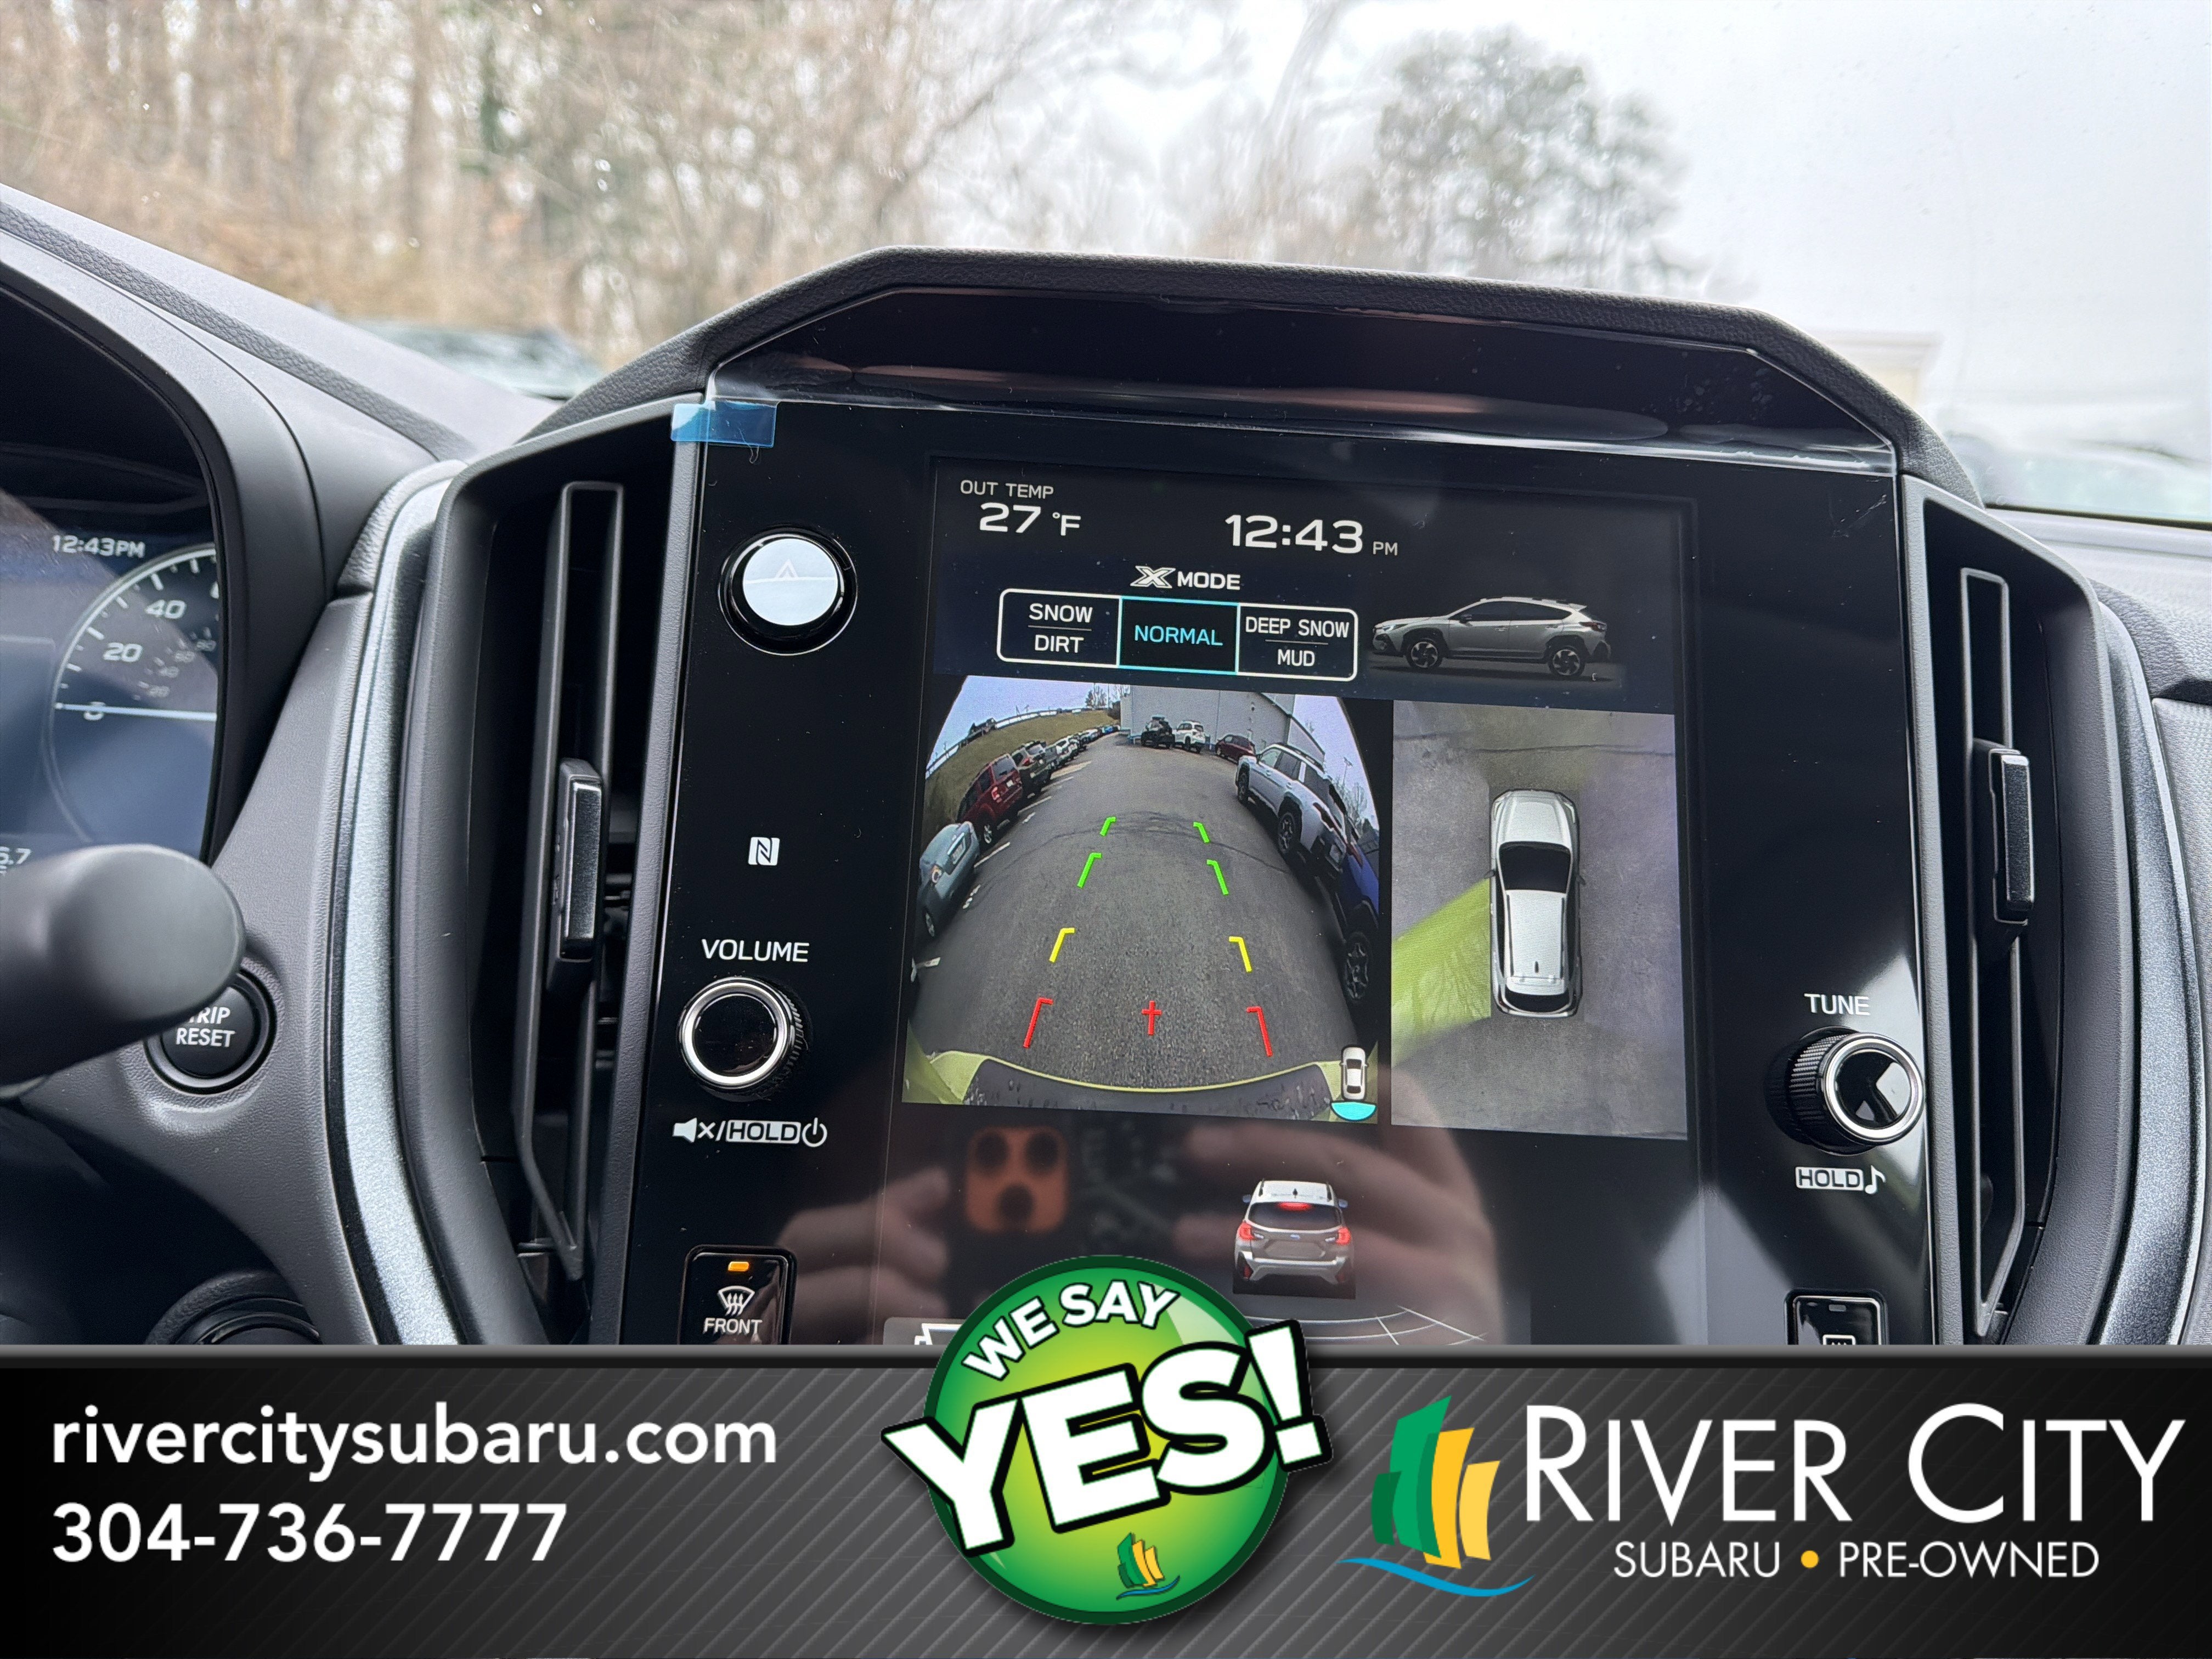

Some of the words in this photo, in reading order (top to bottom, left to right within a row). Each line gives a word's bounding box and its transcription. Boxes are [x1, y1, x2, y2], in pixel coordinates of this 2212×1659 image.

[960, 479, 998, 496] OUT
[1006, 483, 1054, 500] TEMP
[978, 502, 1042, 534] 27
[1225, 514, 1363, 555] 12:43
[1373, 540, 1398, 556] PM
[1177, 571, 1241, 591] MODE
[145, 599, 187, 619] 40
[1028, 602, 1093, 623] SNOW
[1134, 624, 1223, 647] NORMAL
[1245, 616, 1291, 635] DEEP
[1297, 619, 1350, 639] SNOW
[103, 641, 143, 662] 20
[1034, 634, 1084, 654] DIRT
[1277, 649, 1316, 667] MUD
[701, 938, 810, 963] VOLUME
[1803, 992, 1871, 1016] TUNE
[175, 1027, 236, 1048] RESET
[1797, 1167, 1863, 1189] HOLD
[703, 1317, 763, 1335] FRONT
